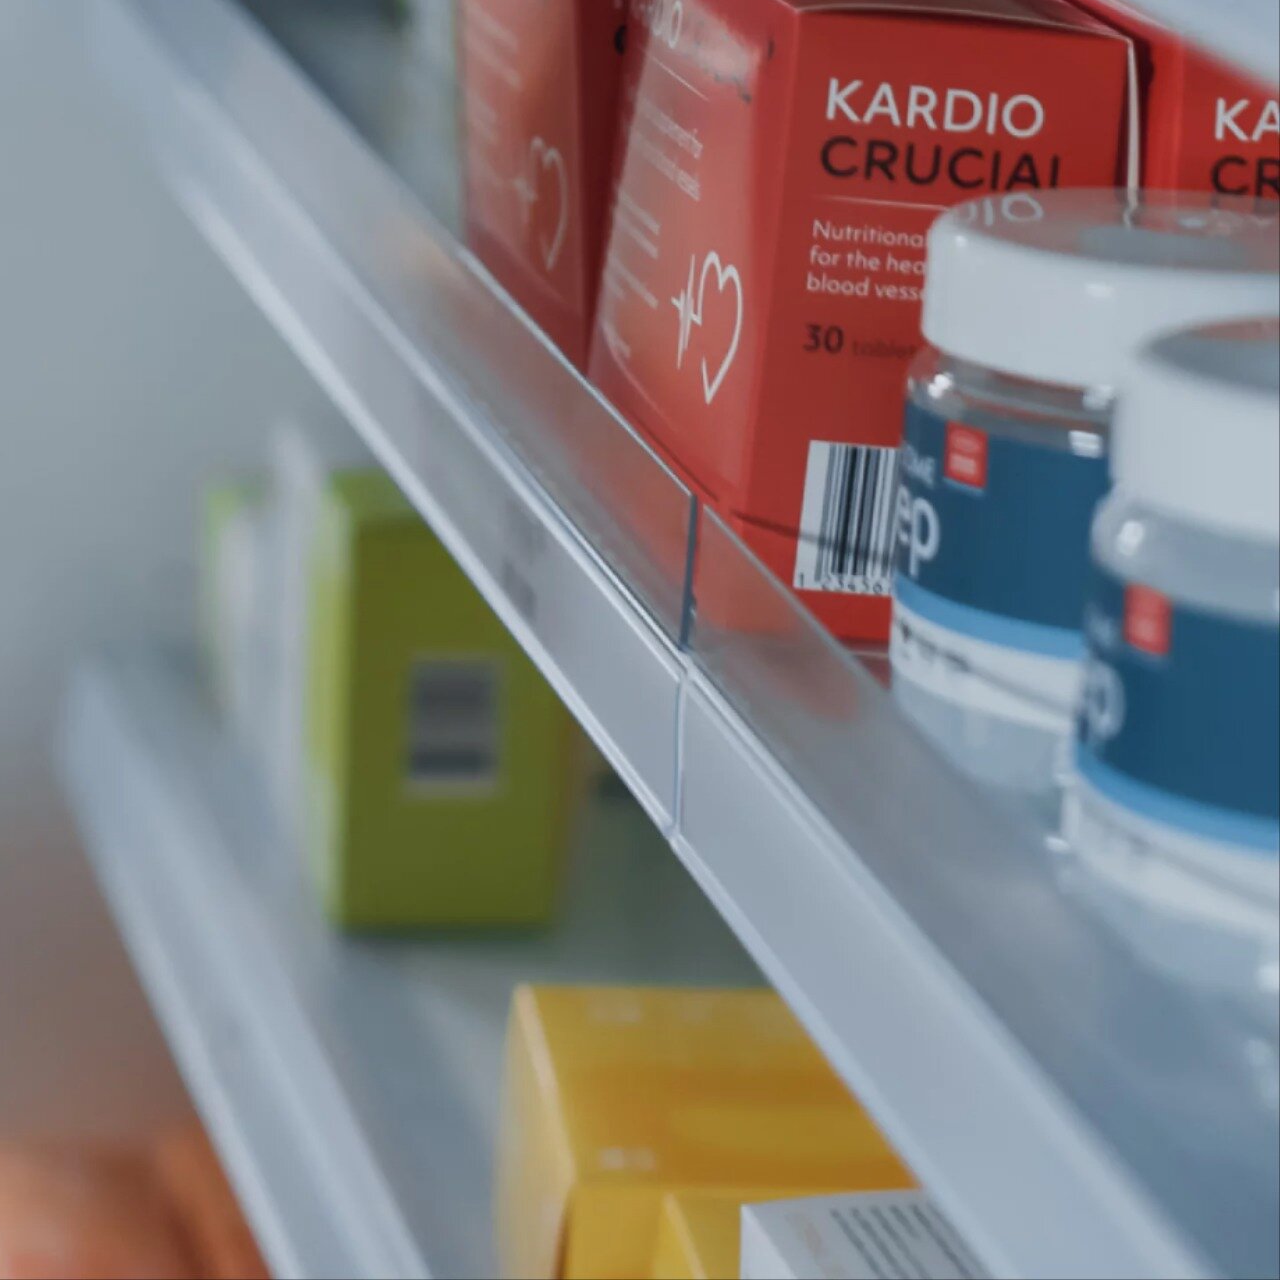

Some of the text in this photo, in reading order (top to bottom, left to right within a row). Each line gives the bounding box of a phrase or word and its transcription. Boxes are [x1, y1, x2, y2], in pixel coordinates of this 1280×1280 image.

[825, 77, 1045, 139] KARDIO
[809, 244, 840, 266] for
[846, 249, 881, 271] the
[806, 271, 870, 297] blood
[802, 322, 845, 355] 30
